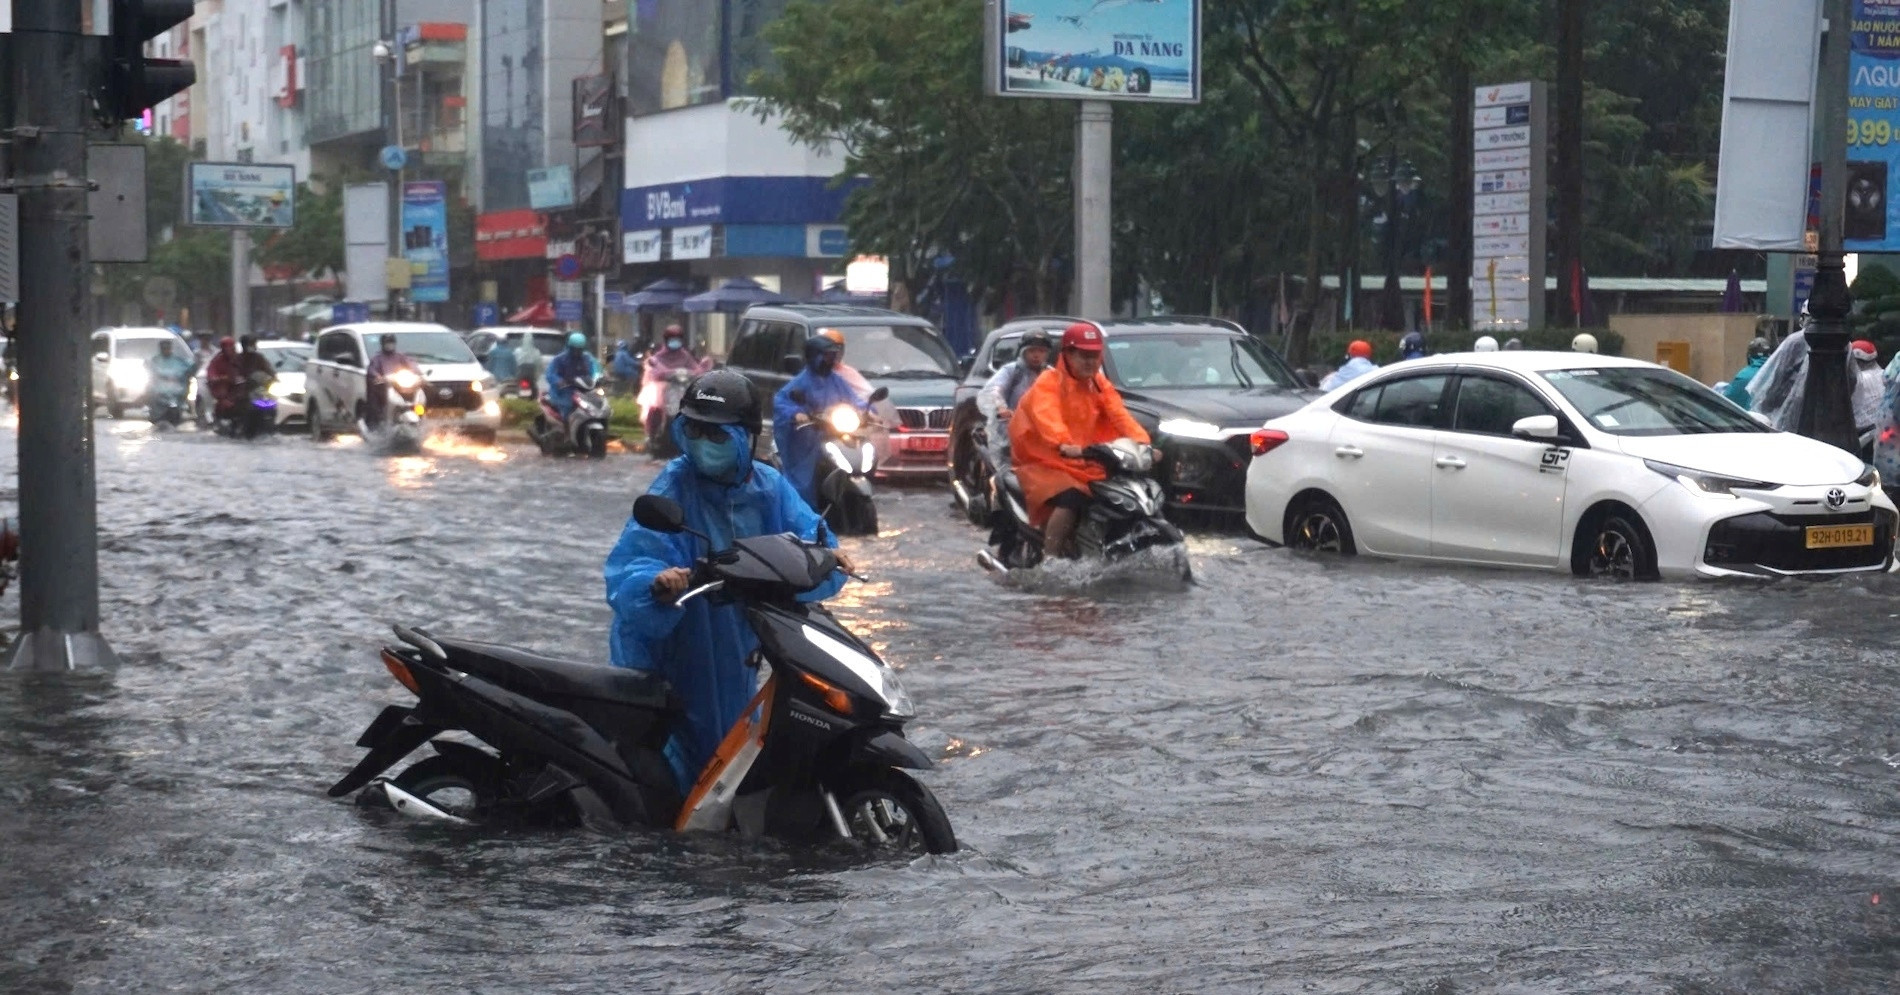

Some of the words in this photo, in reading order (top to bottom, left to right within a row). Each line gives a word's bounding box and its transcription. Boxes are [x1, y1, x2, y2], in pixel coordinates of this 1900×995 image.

[1113, 41, 1134, 56] DA
[1141, 42, 1184, 57] NANG
[647, 190, 687, 221] BVBank
[790, 710, 831, 731] HONDA
